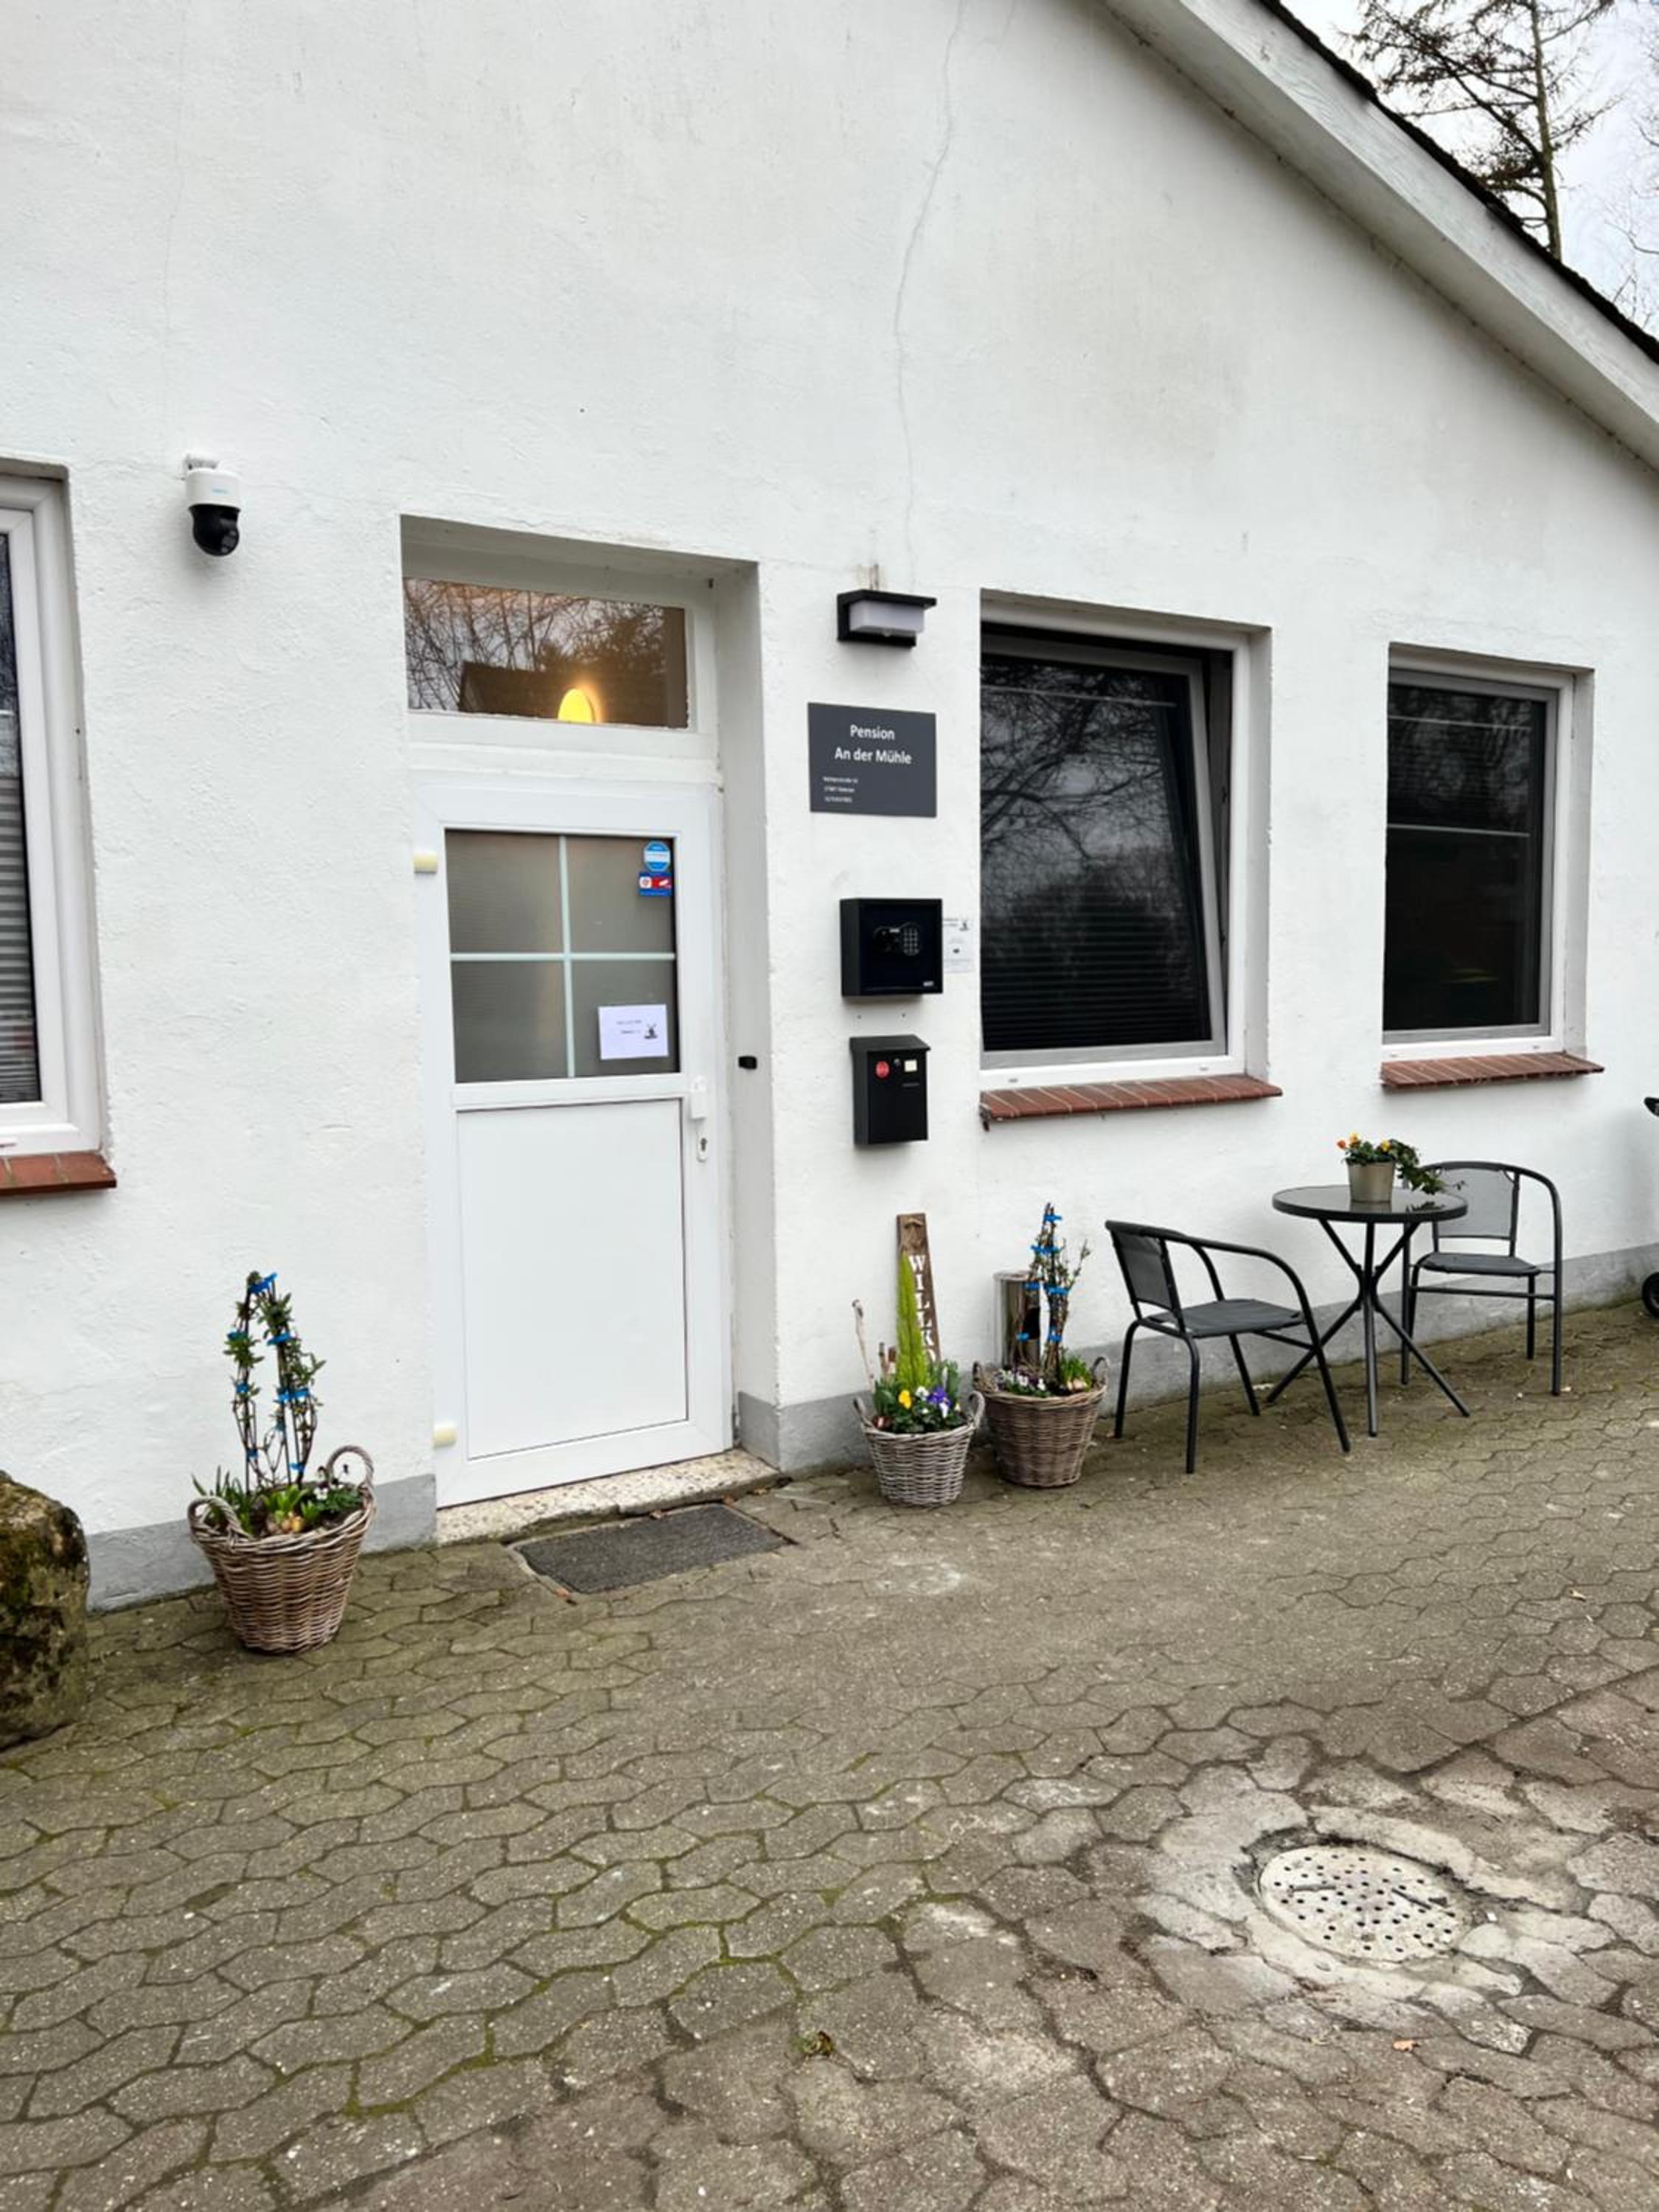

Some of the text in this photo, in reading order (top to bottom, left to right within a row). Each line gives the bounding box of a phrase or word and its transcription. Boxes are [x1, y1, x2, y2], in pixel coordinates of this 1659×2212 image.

[850, 724, 895, 740] Pension
[835, 747, 912, 764] An der Mühle
